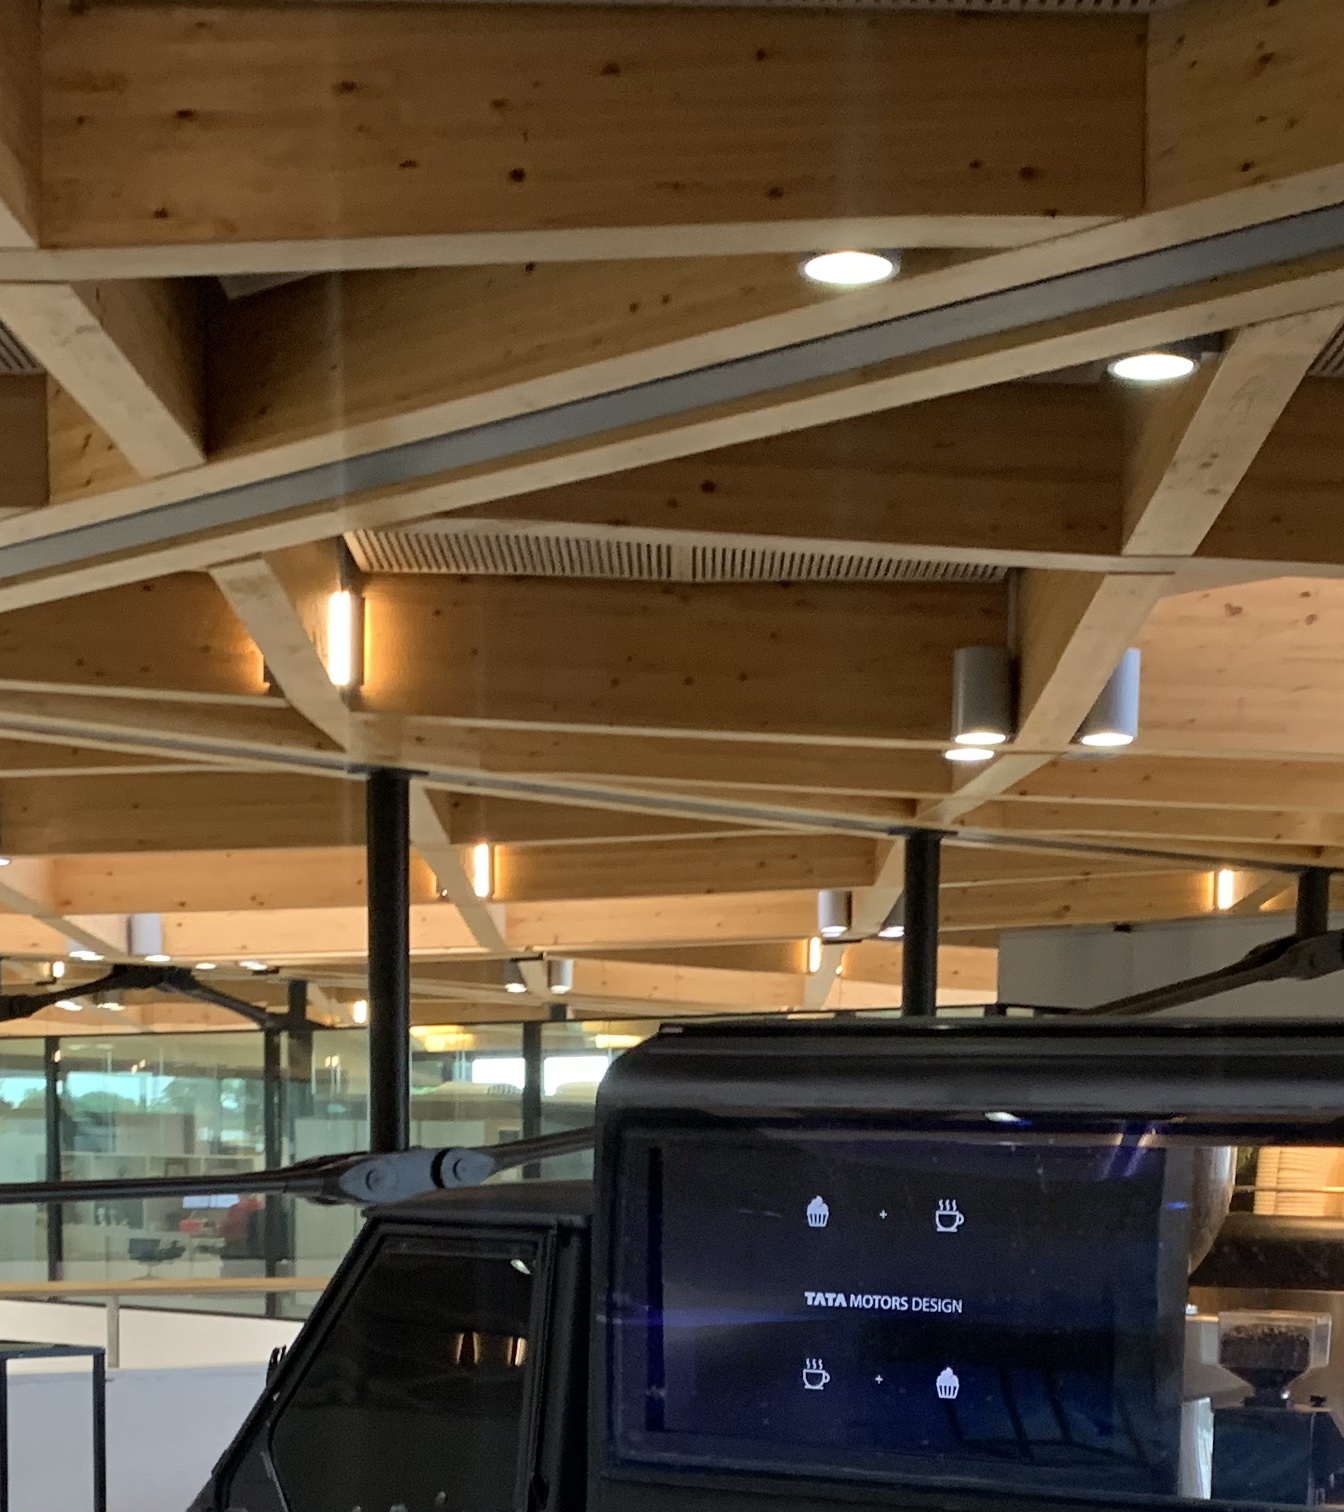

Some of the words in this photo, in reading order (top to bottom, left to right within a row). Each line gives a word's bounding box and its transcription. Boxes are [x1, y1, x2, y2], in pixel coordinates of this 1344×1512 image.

[804, 1291, 847, 1307] TATA
[850, 1294, 908, 1311] MOTORS
[912, 1297, 963, 1314] DESIGN
